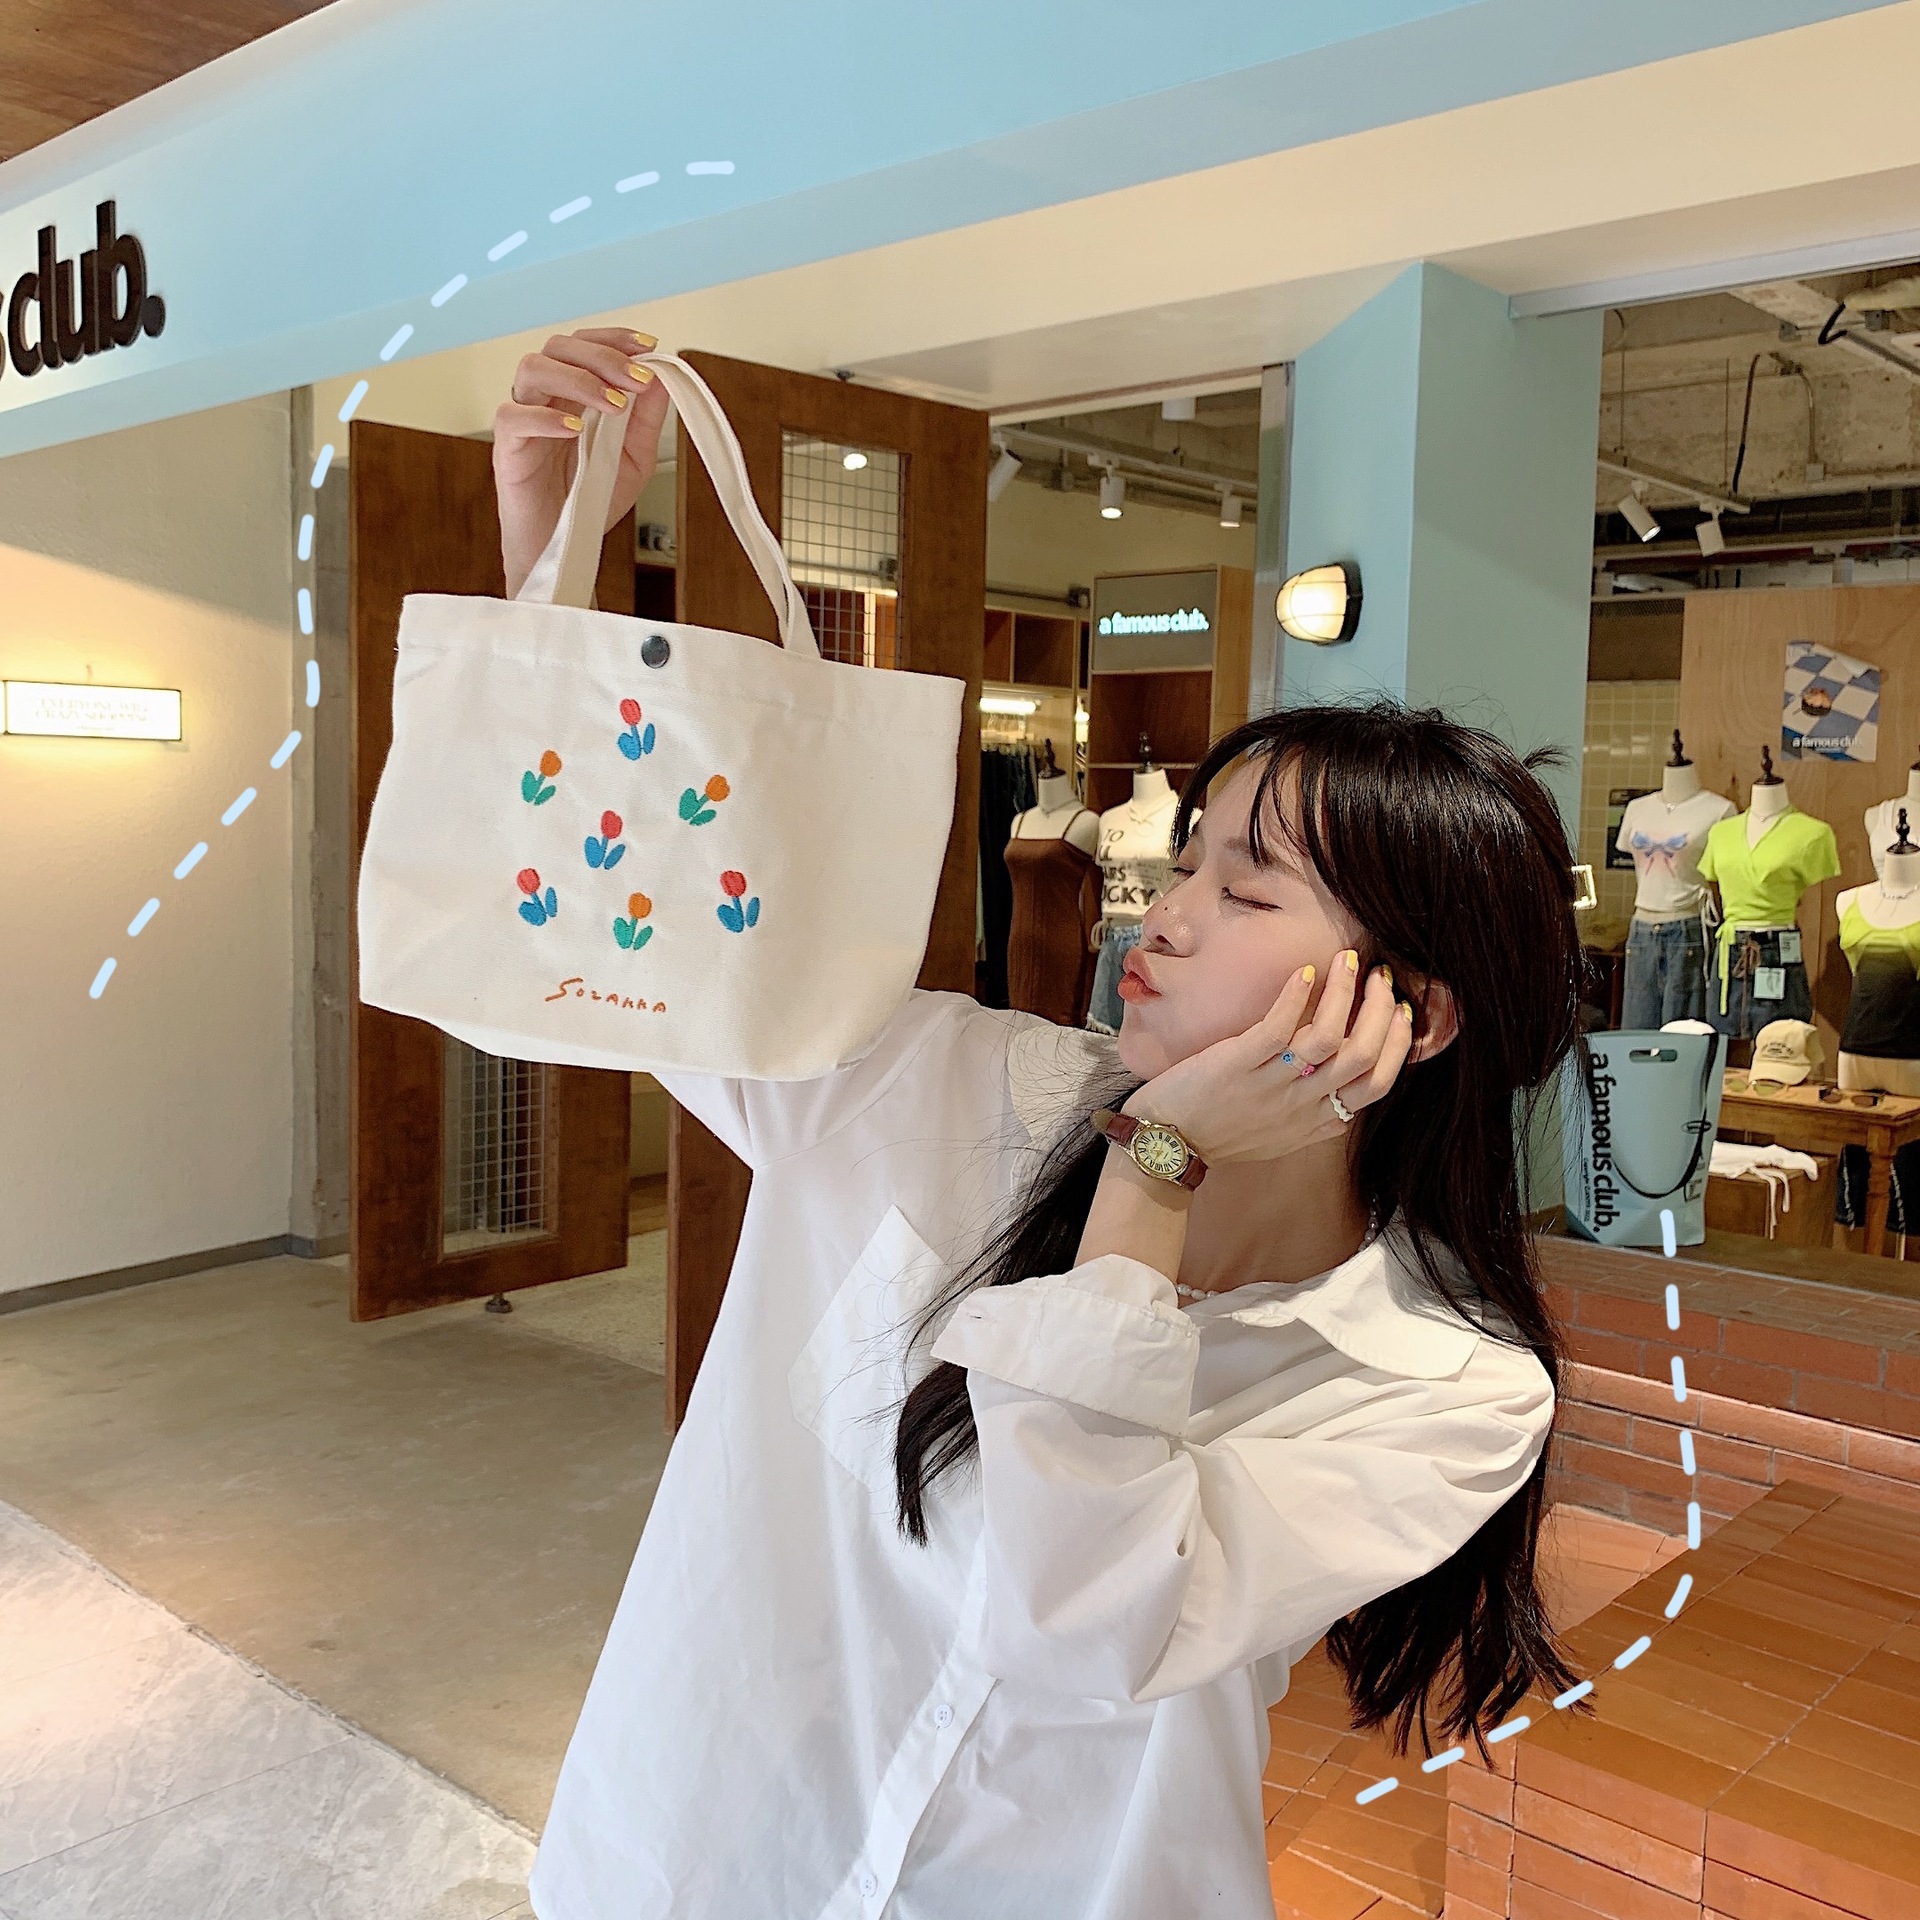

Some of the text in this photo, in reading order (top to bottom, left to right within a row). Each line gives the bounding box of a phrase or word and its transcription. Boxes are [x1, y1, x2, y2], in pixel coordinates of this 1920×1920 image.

[8, 200, 166, 377] club.
[1099, 617, 1112, 634] a
[1112, 612, 1170, 633] famous
[1792, 737, 1800, 747] a
[1801, 735, 1840, 747] famous
[1590, 1053, 1620, 1233] a famous club.
